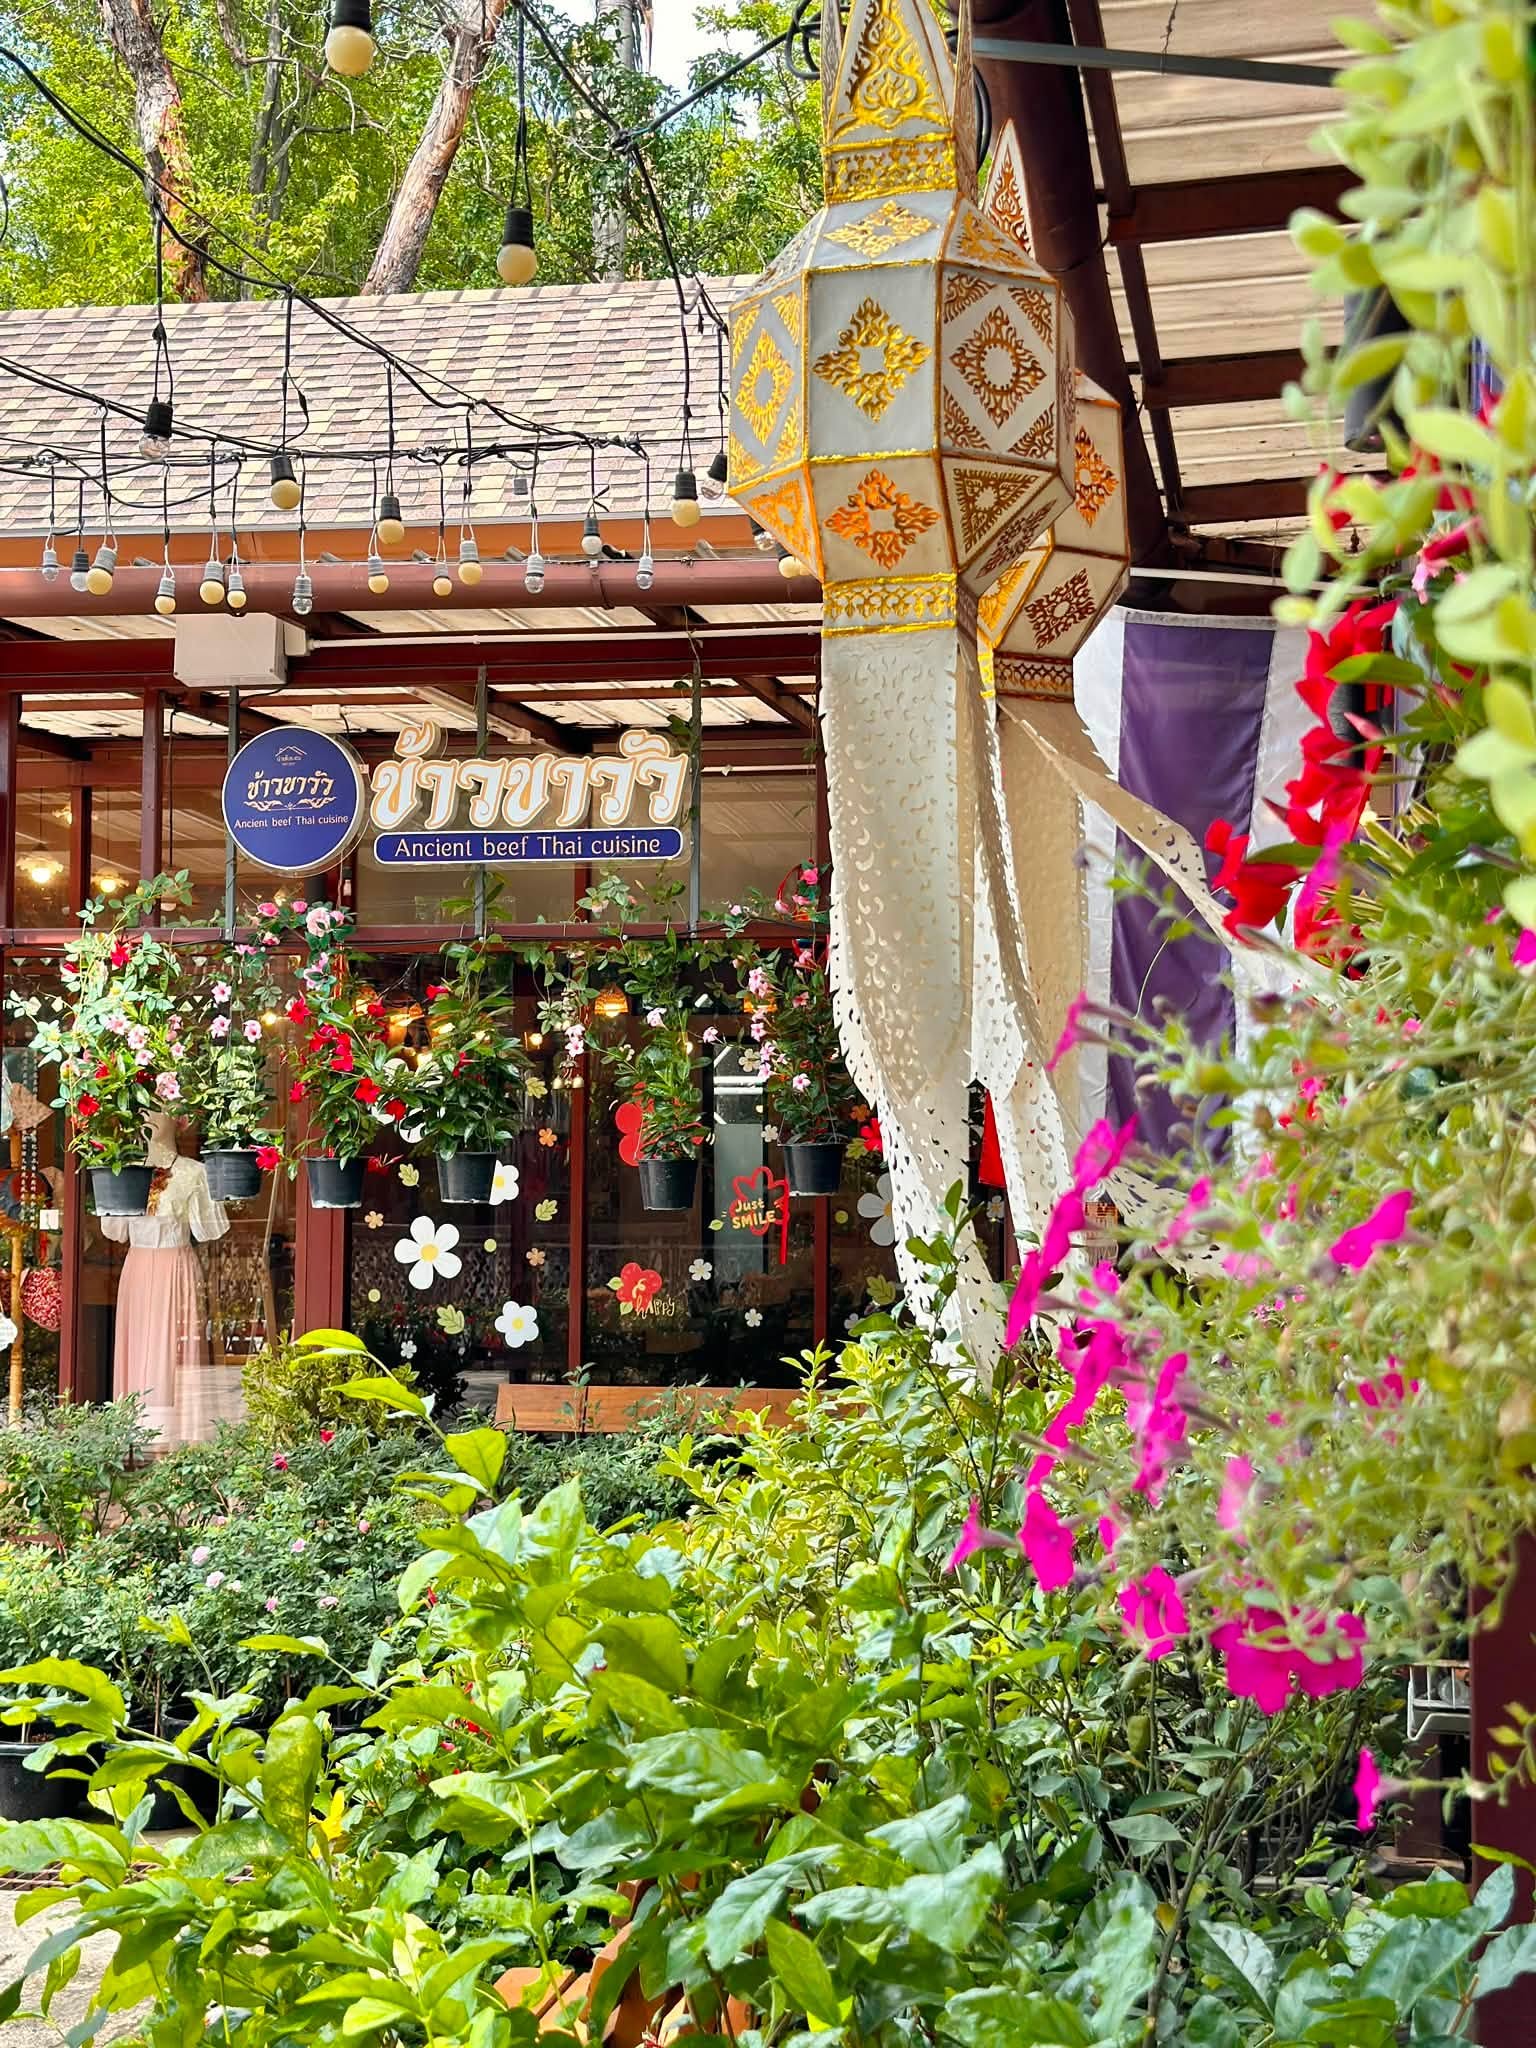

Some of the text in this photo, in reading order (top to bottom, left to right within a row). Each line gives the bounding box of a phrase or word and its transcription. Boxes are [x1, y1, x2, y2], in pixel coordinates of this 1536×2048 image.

[247, 770, 334, 800] ข้าวขาวัว
[369, 721, 690, 831] ข้าวขาวัว
[234, 814, 349, 829] Ancient beef Thai cuisine
[395, 835, 661, 858] Ancient beef Thai cuisine
[735, 1198, 765, 1213] Just
[732, 1210, 776, 1229] SMILE
